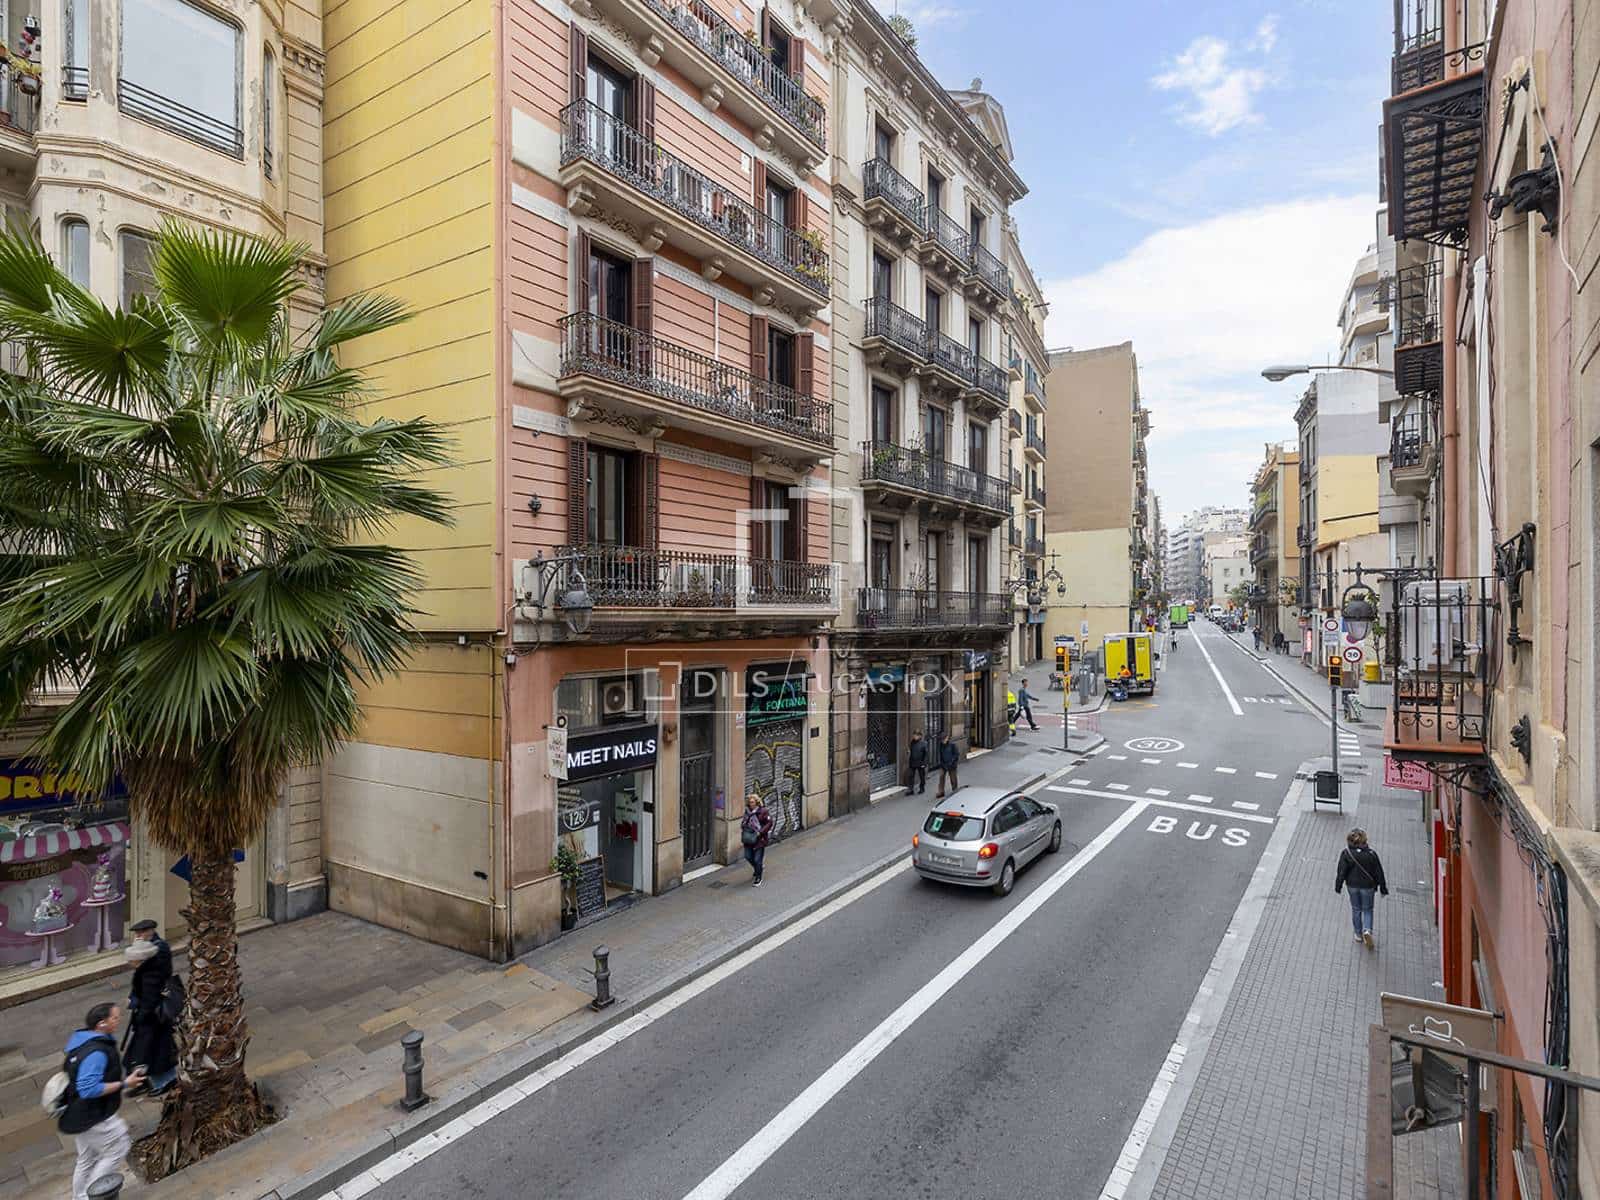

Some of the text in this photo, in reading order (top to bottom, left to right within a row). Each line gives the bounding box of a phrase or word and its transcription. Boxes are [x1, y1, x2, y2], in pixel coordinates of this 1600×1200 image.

[567, 746, 611, 769] MEET
[612, 739, 657, 760] NAILS
[1136, 740, 1172, 750] 30
[1146, 815, 1251, 847] BUS
